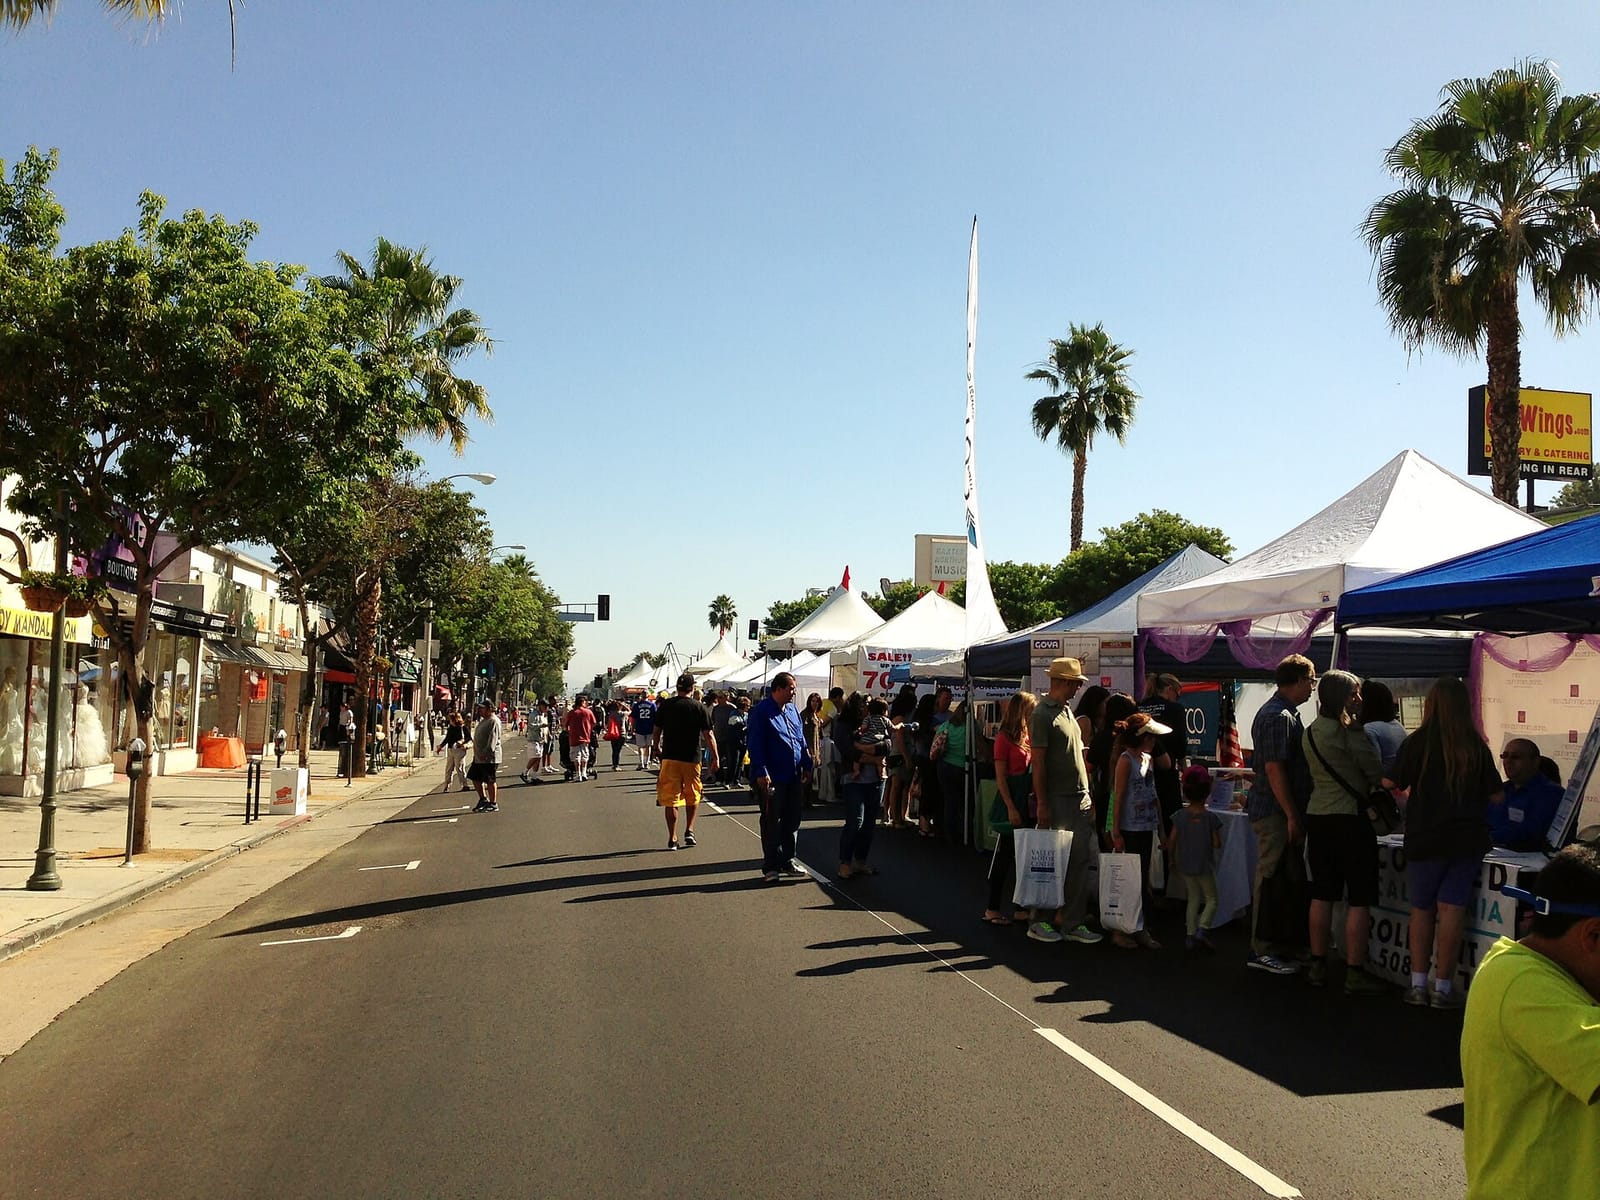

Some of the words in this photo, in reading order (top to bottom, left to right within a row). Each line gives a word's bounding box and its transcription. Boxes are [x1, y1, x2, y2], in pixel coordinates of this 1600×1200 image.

[1534, 448, 1540, 456] &
[1543, 449, 1590, 460] CATERING
[1543, 464, 1555, 474] IN
[1559, 466, 1588, 476] REAR
[107, 559, 138, 581] BOUTIQUE
[934, 565, 967, 575] MUSIC
[1034, 641, 1059, 649] GOYA
[639, 709, 651, 719] 22
